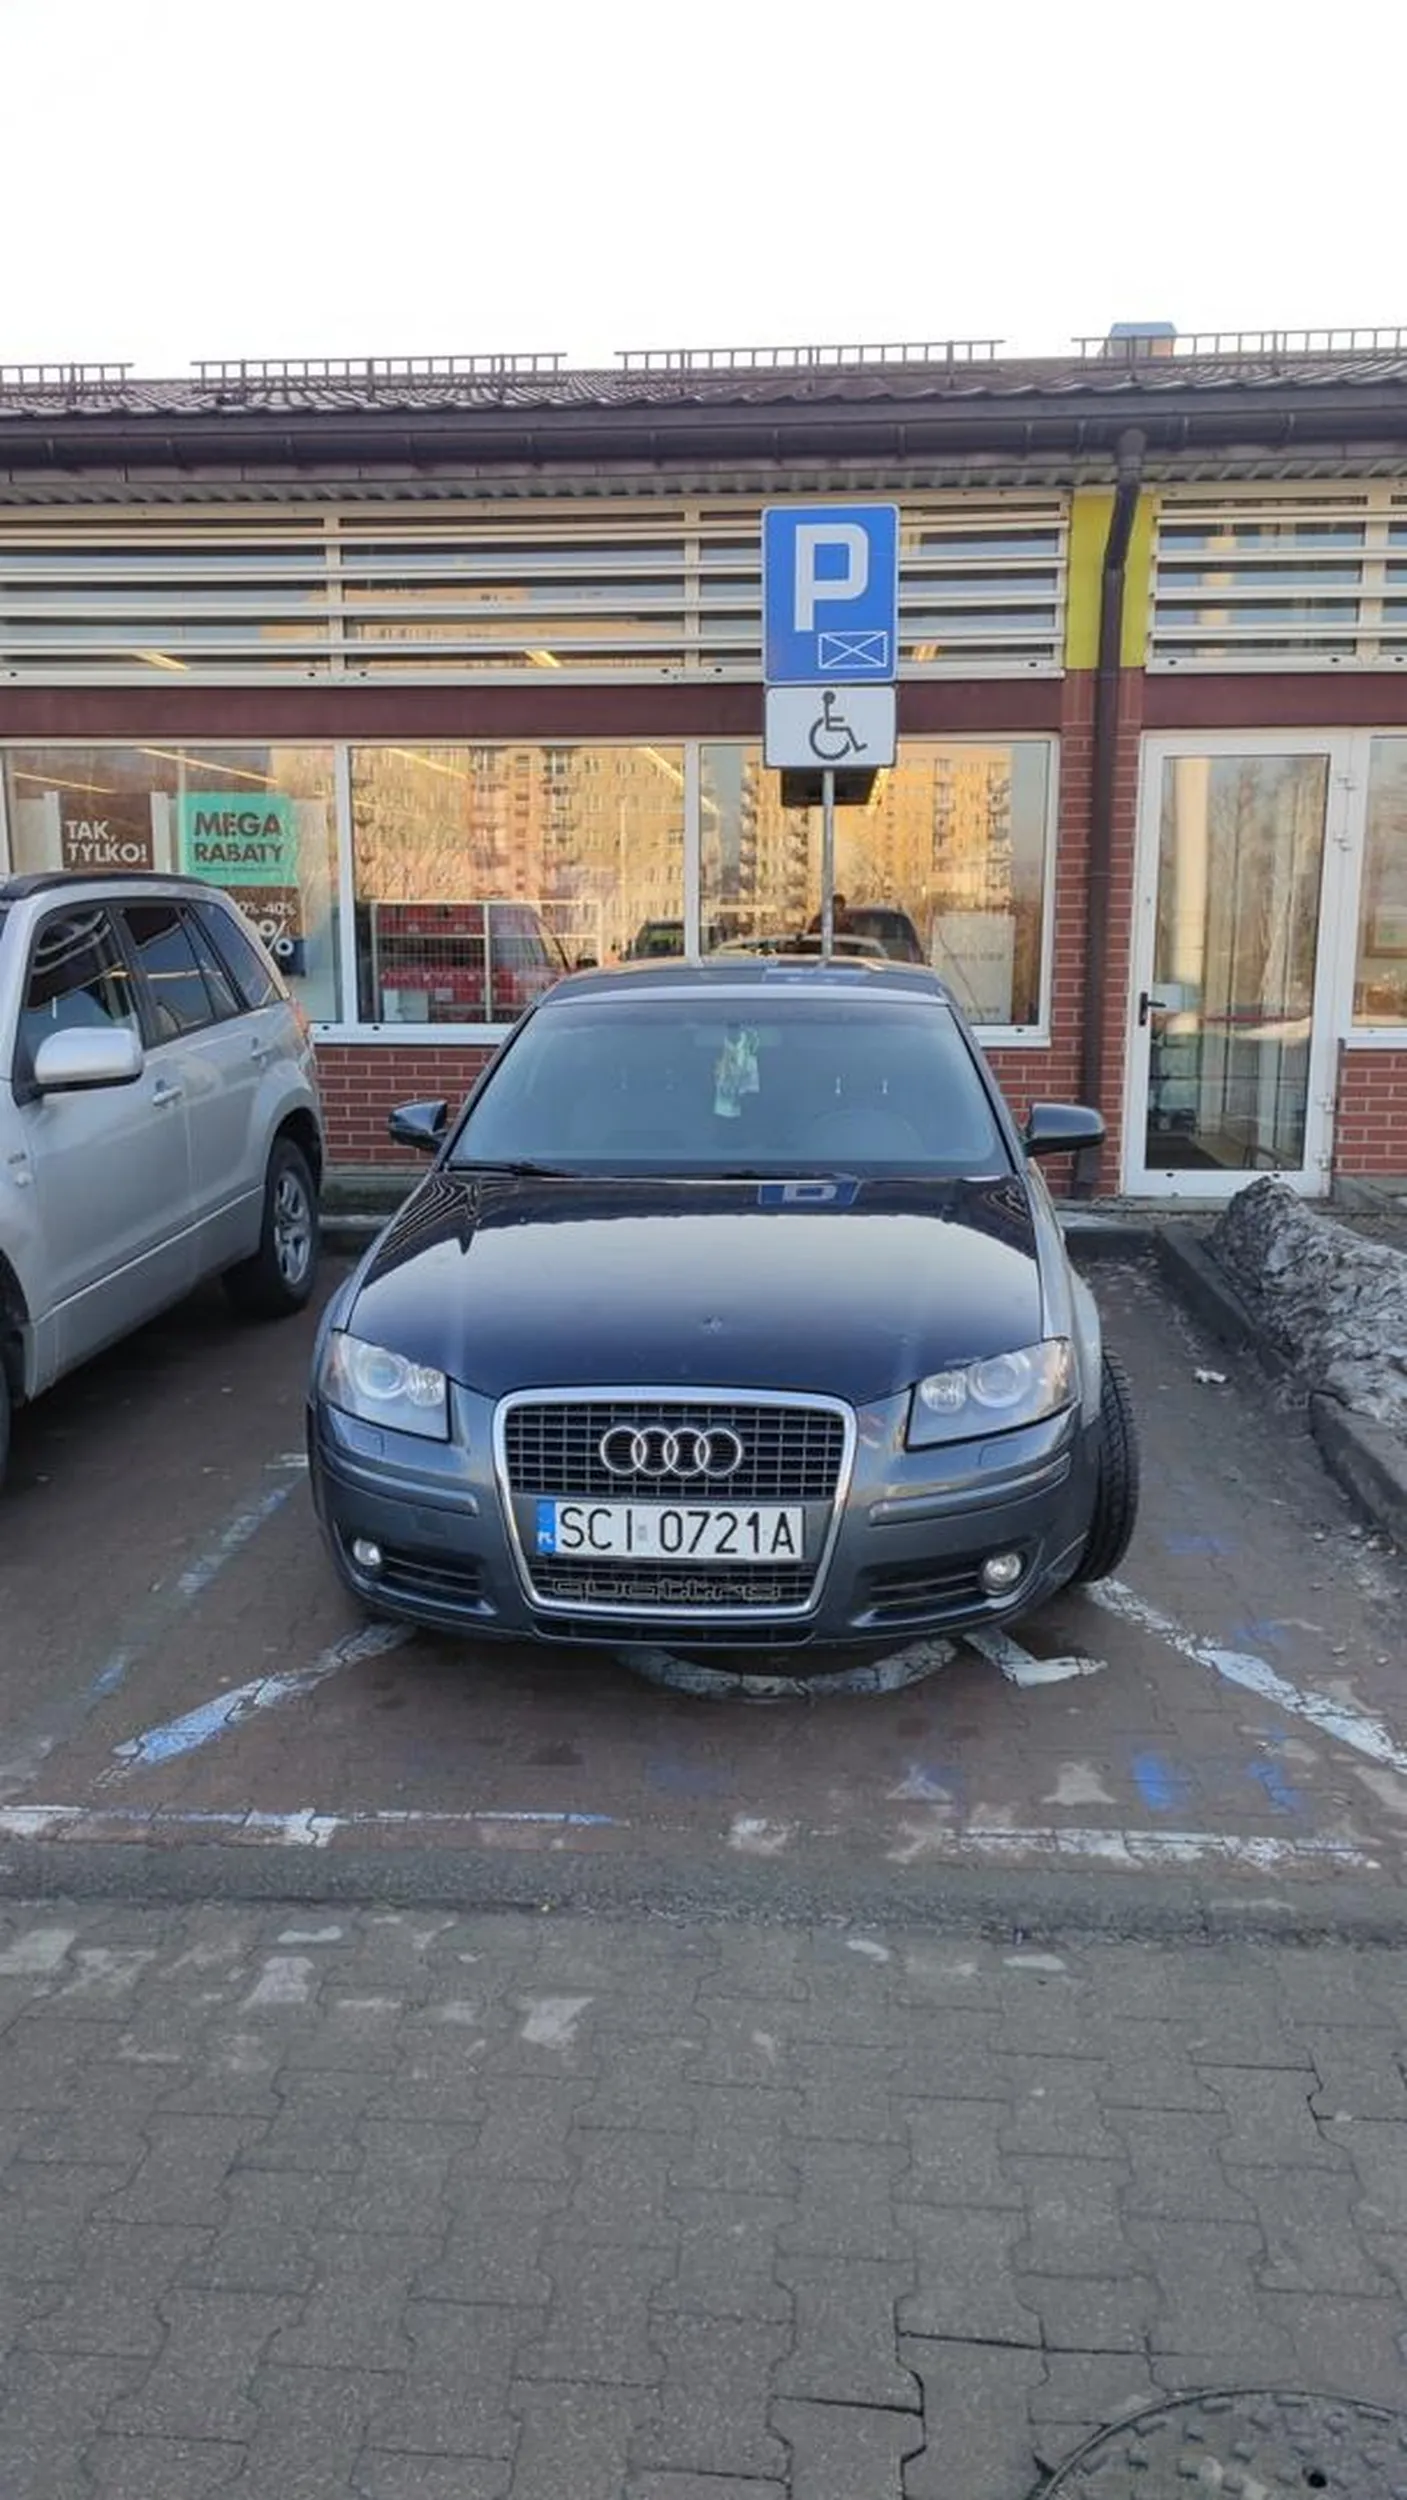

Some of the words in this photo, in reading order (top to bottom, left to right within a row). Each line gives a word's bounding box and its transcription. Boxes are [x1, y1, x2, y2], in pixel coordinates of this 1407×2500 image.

[794, 523, 869, 632] P
[65, 820, 116, 843] TAK,
[194, 812, 282, 838] MEGA
[67, 842, 148, 864] TYLKO!
[194, 842, 284, 863] RABATY
[559, 1506, 633, 1551] SCI
[659, 1509, 796, 1555] 0721A
